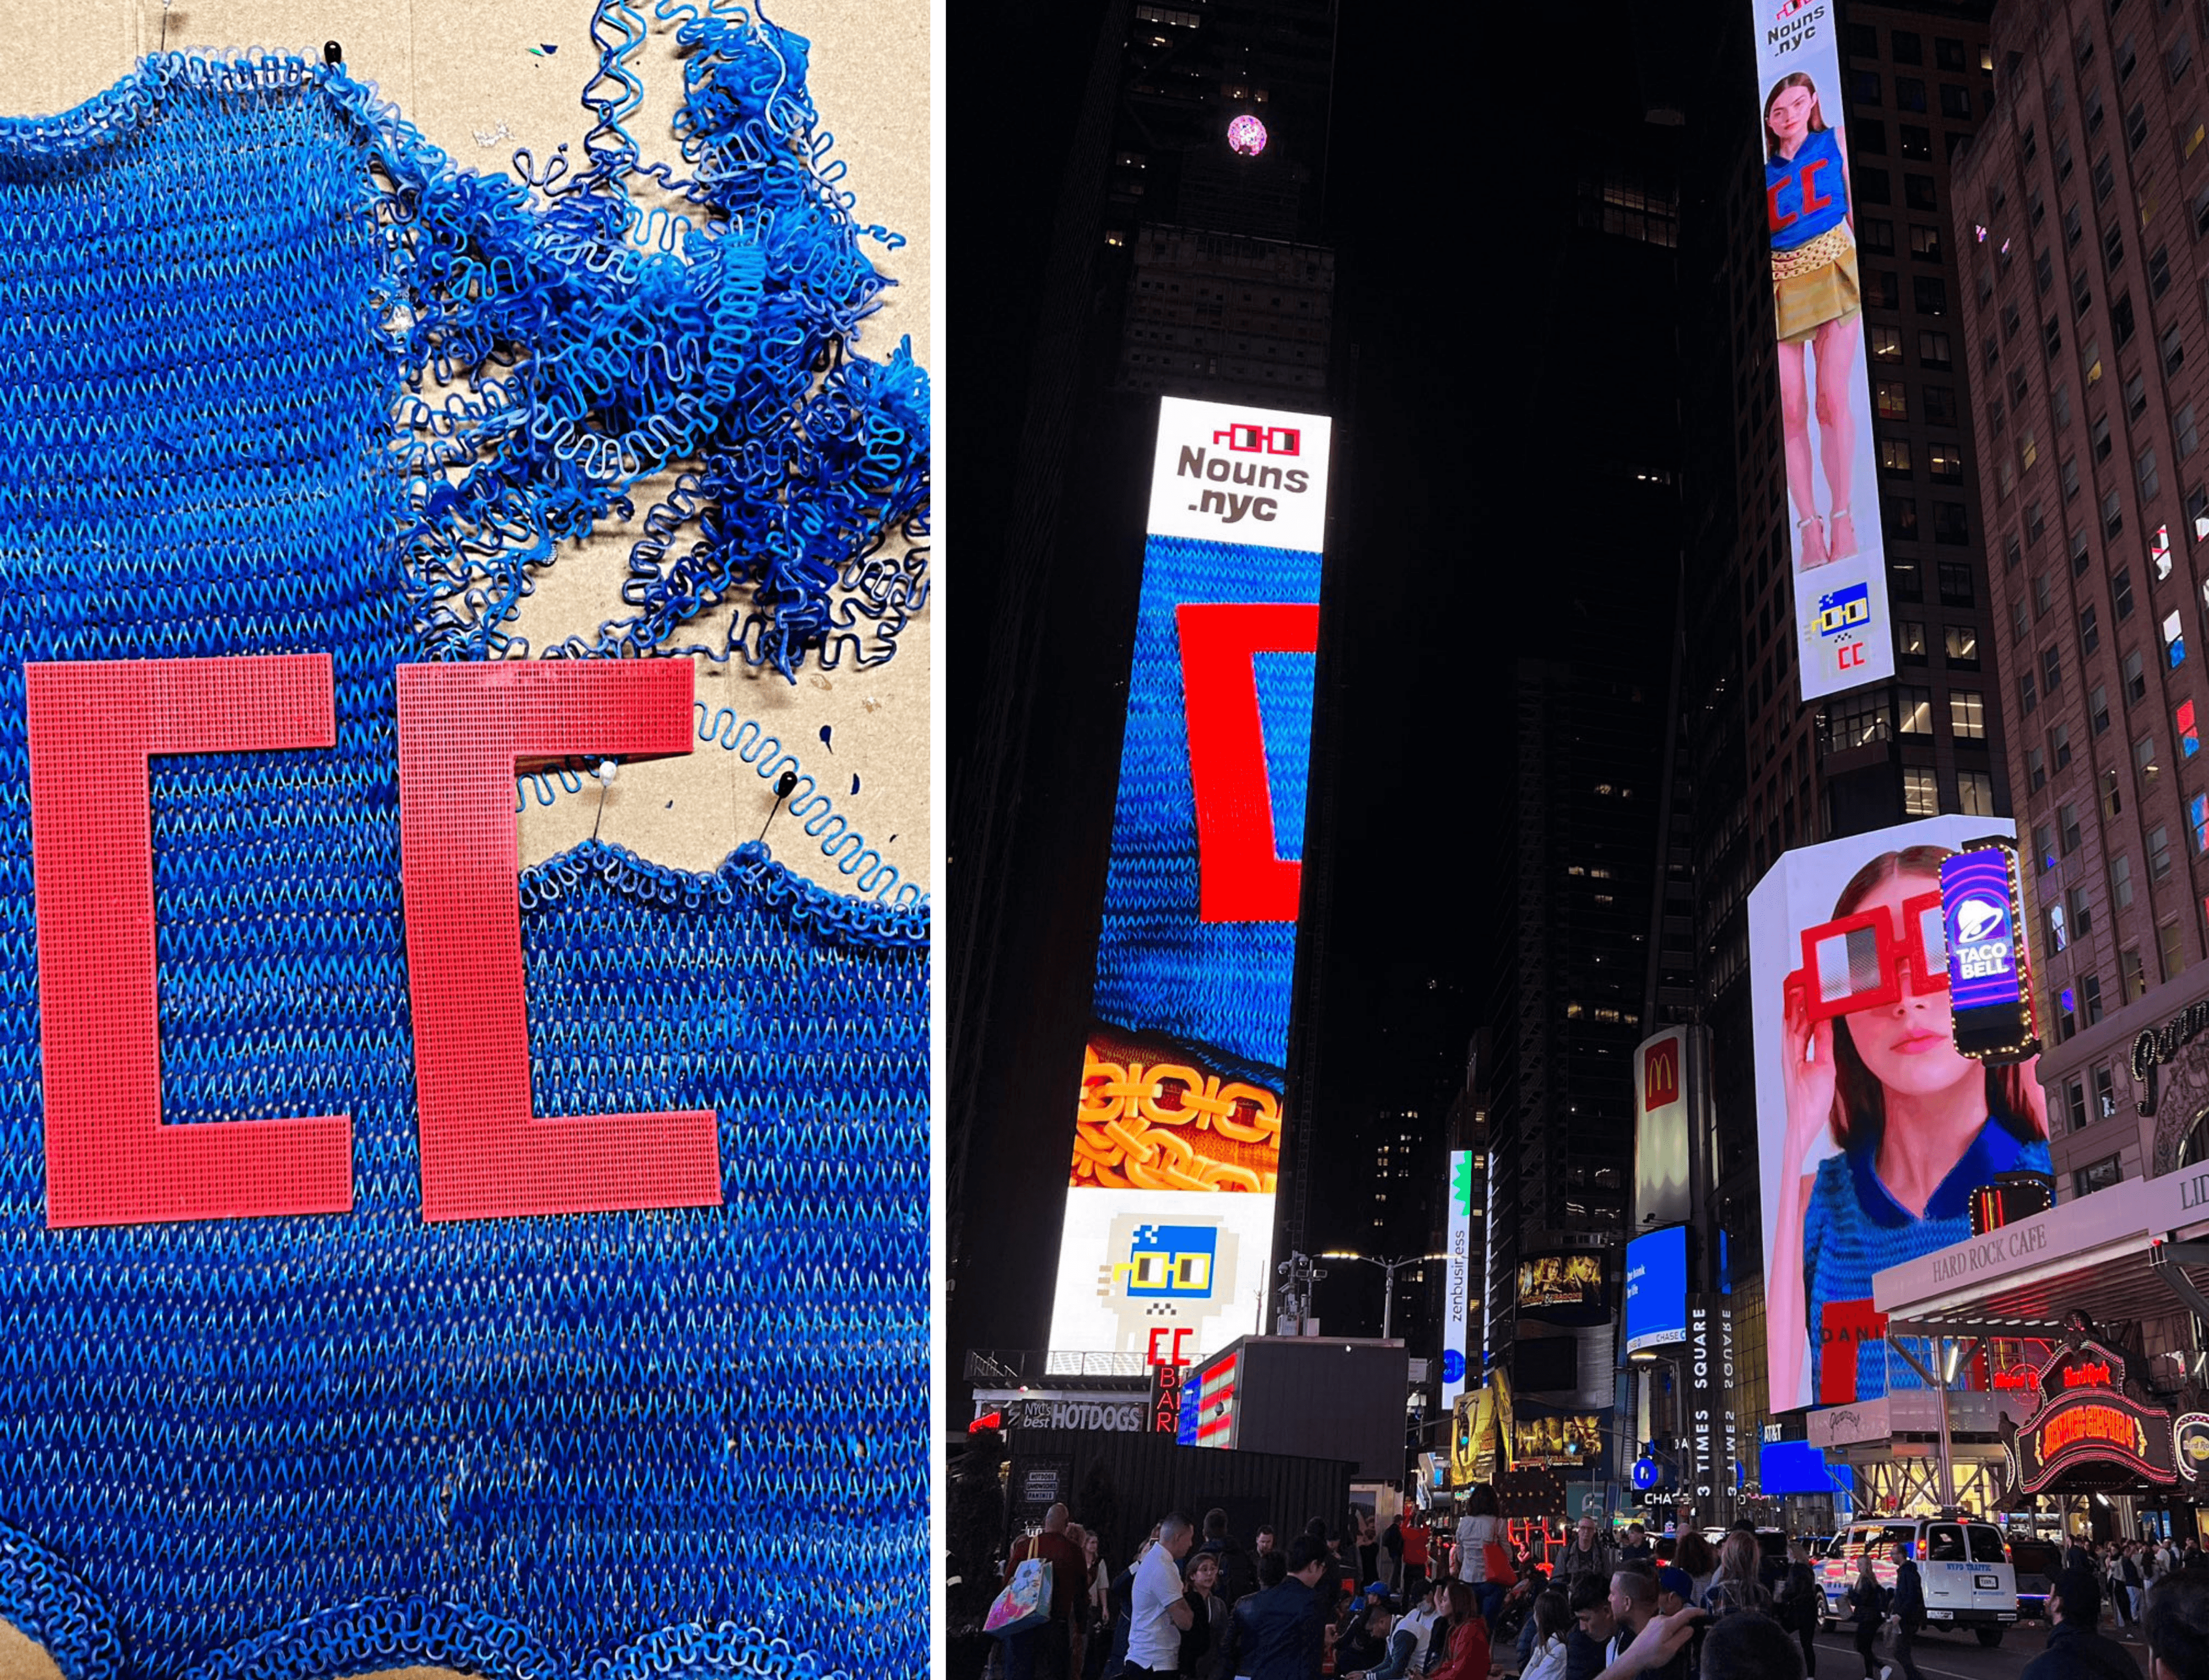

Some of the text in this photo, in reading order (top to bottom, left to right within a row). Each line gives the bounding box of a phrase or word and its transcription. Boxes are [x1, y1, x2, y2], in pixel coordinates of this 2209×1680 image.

[1768, 5, 1825, 45] Nouns
[1774, 26, 1816, 57] .nyc
[1177, 445, 1310, 493] Nouns
[1188, 489, 1278, 524] .nyc
[1838, 642, 1865, 670] CC
[1956, 942, 2007, 964] TACO
[1961, 959, 2010, 980] BELL
[1932, 1224, 2047, 1283] HARD ROCK CAFE
[1656, 1332, 1679, 1343] CHASE
[1024, 1403, 1051, 1416] NYC's
[1051, 1403, 1140, 1431] HOTDOGS
[1693, 1309, 1710, 1497] 3 TIMES SQUARE
[1023, 1414, 1050, 1429] best
[1765, 1423, 1782, 1443] AT&T
